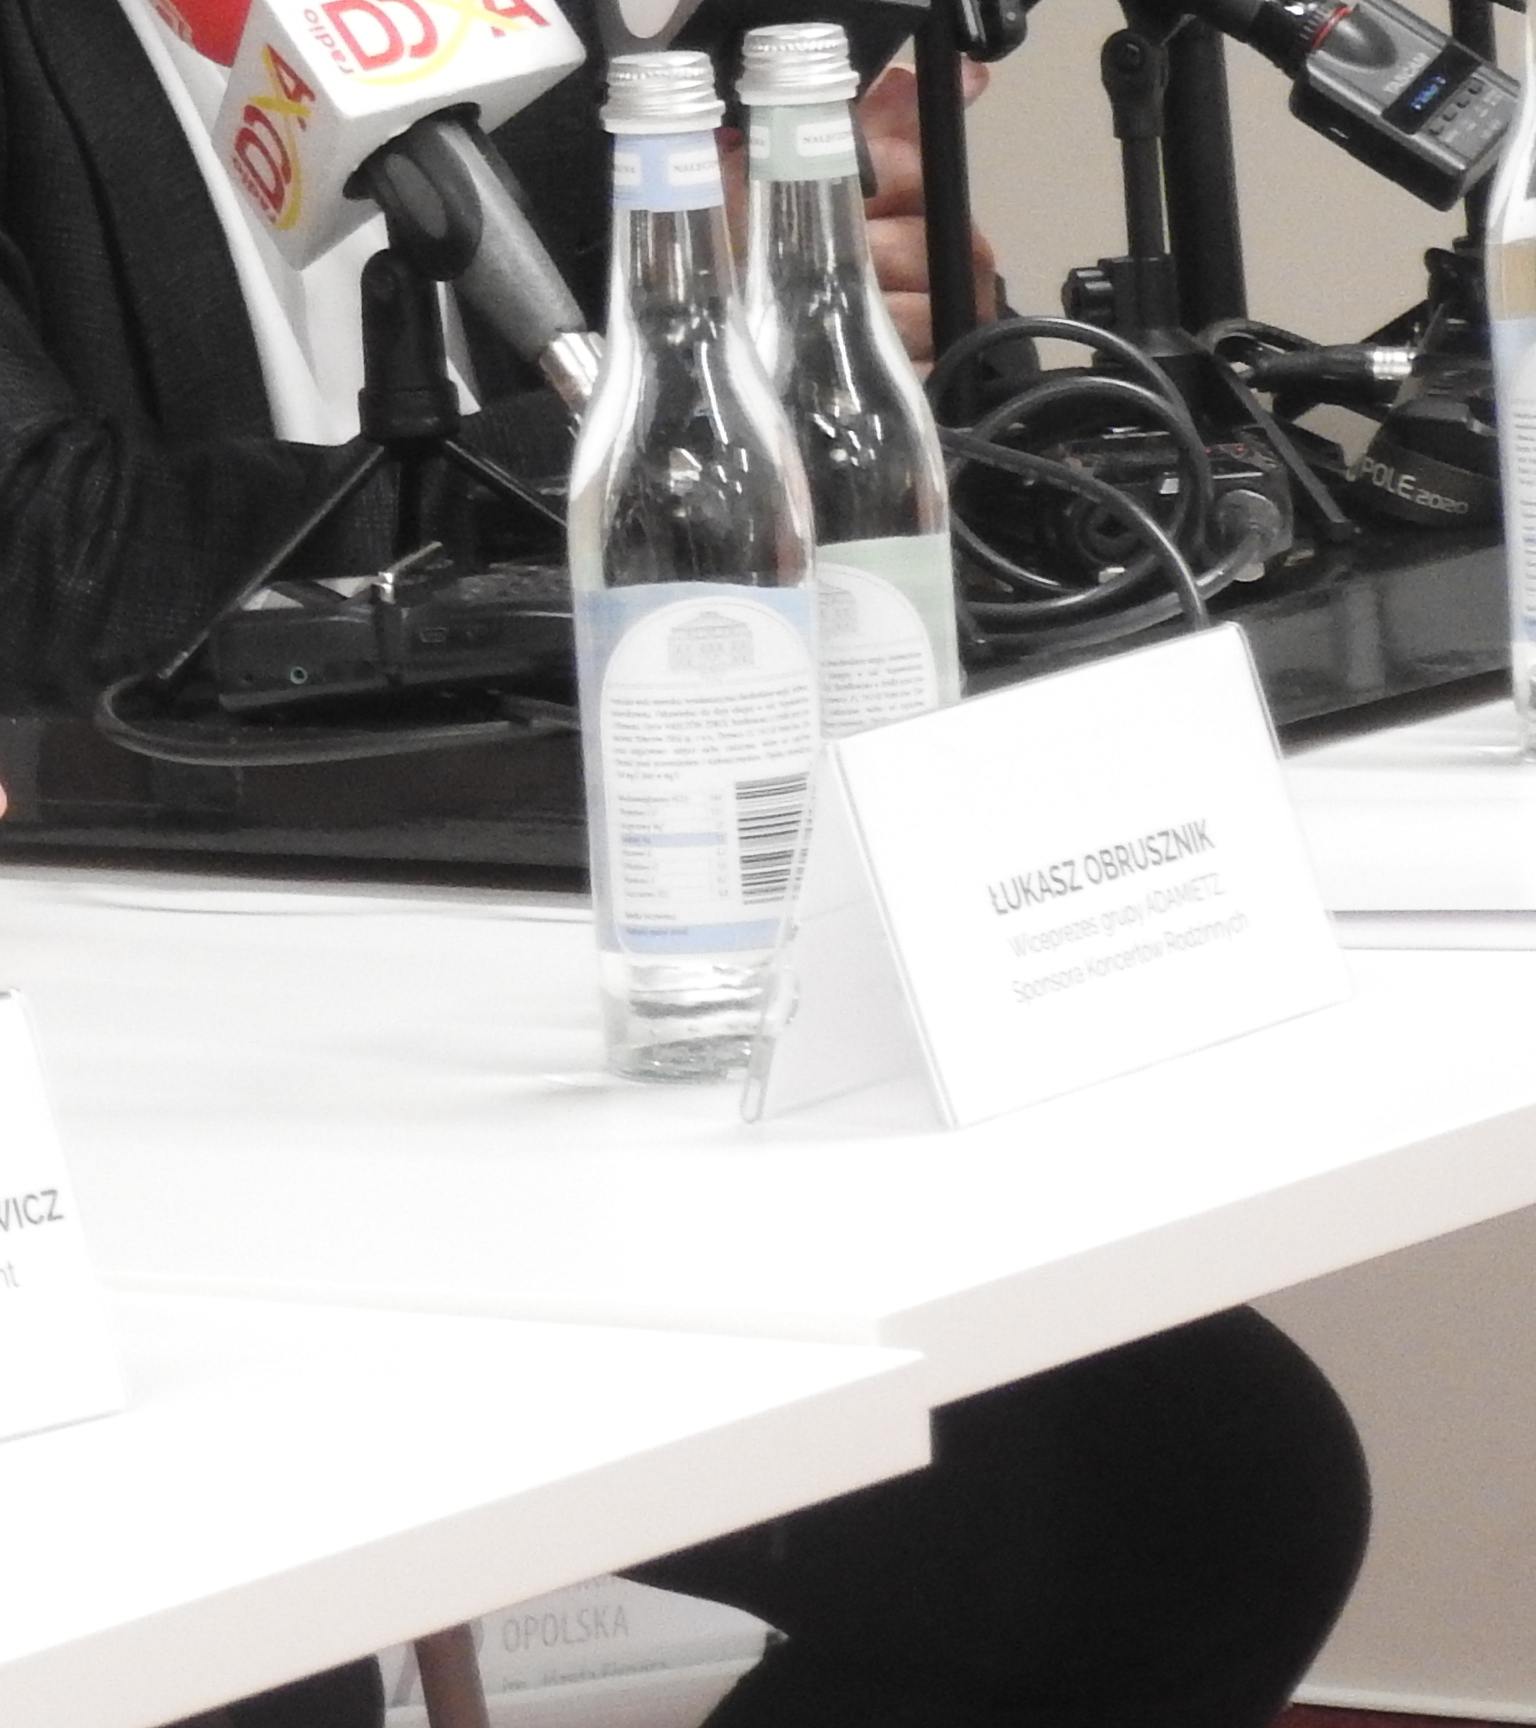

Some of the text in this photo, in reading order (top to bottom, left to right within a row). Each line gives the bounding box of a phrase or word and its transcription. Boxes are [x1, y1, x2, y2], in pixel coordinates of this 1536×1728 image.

[987, 818, 1216, 916] ŁUKASZ OBRUSZNIK
[502, 1604, 630, 1654] OPOLSKA
